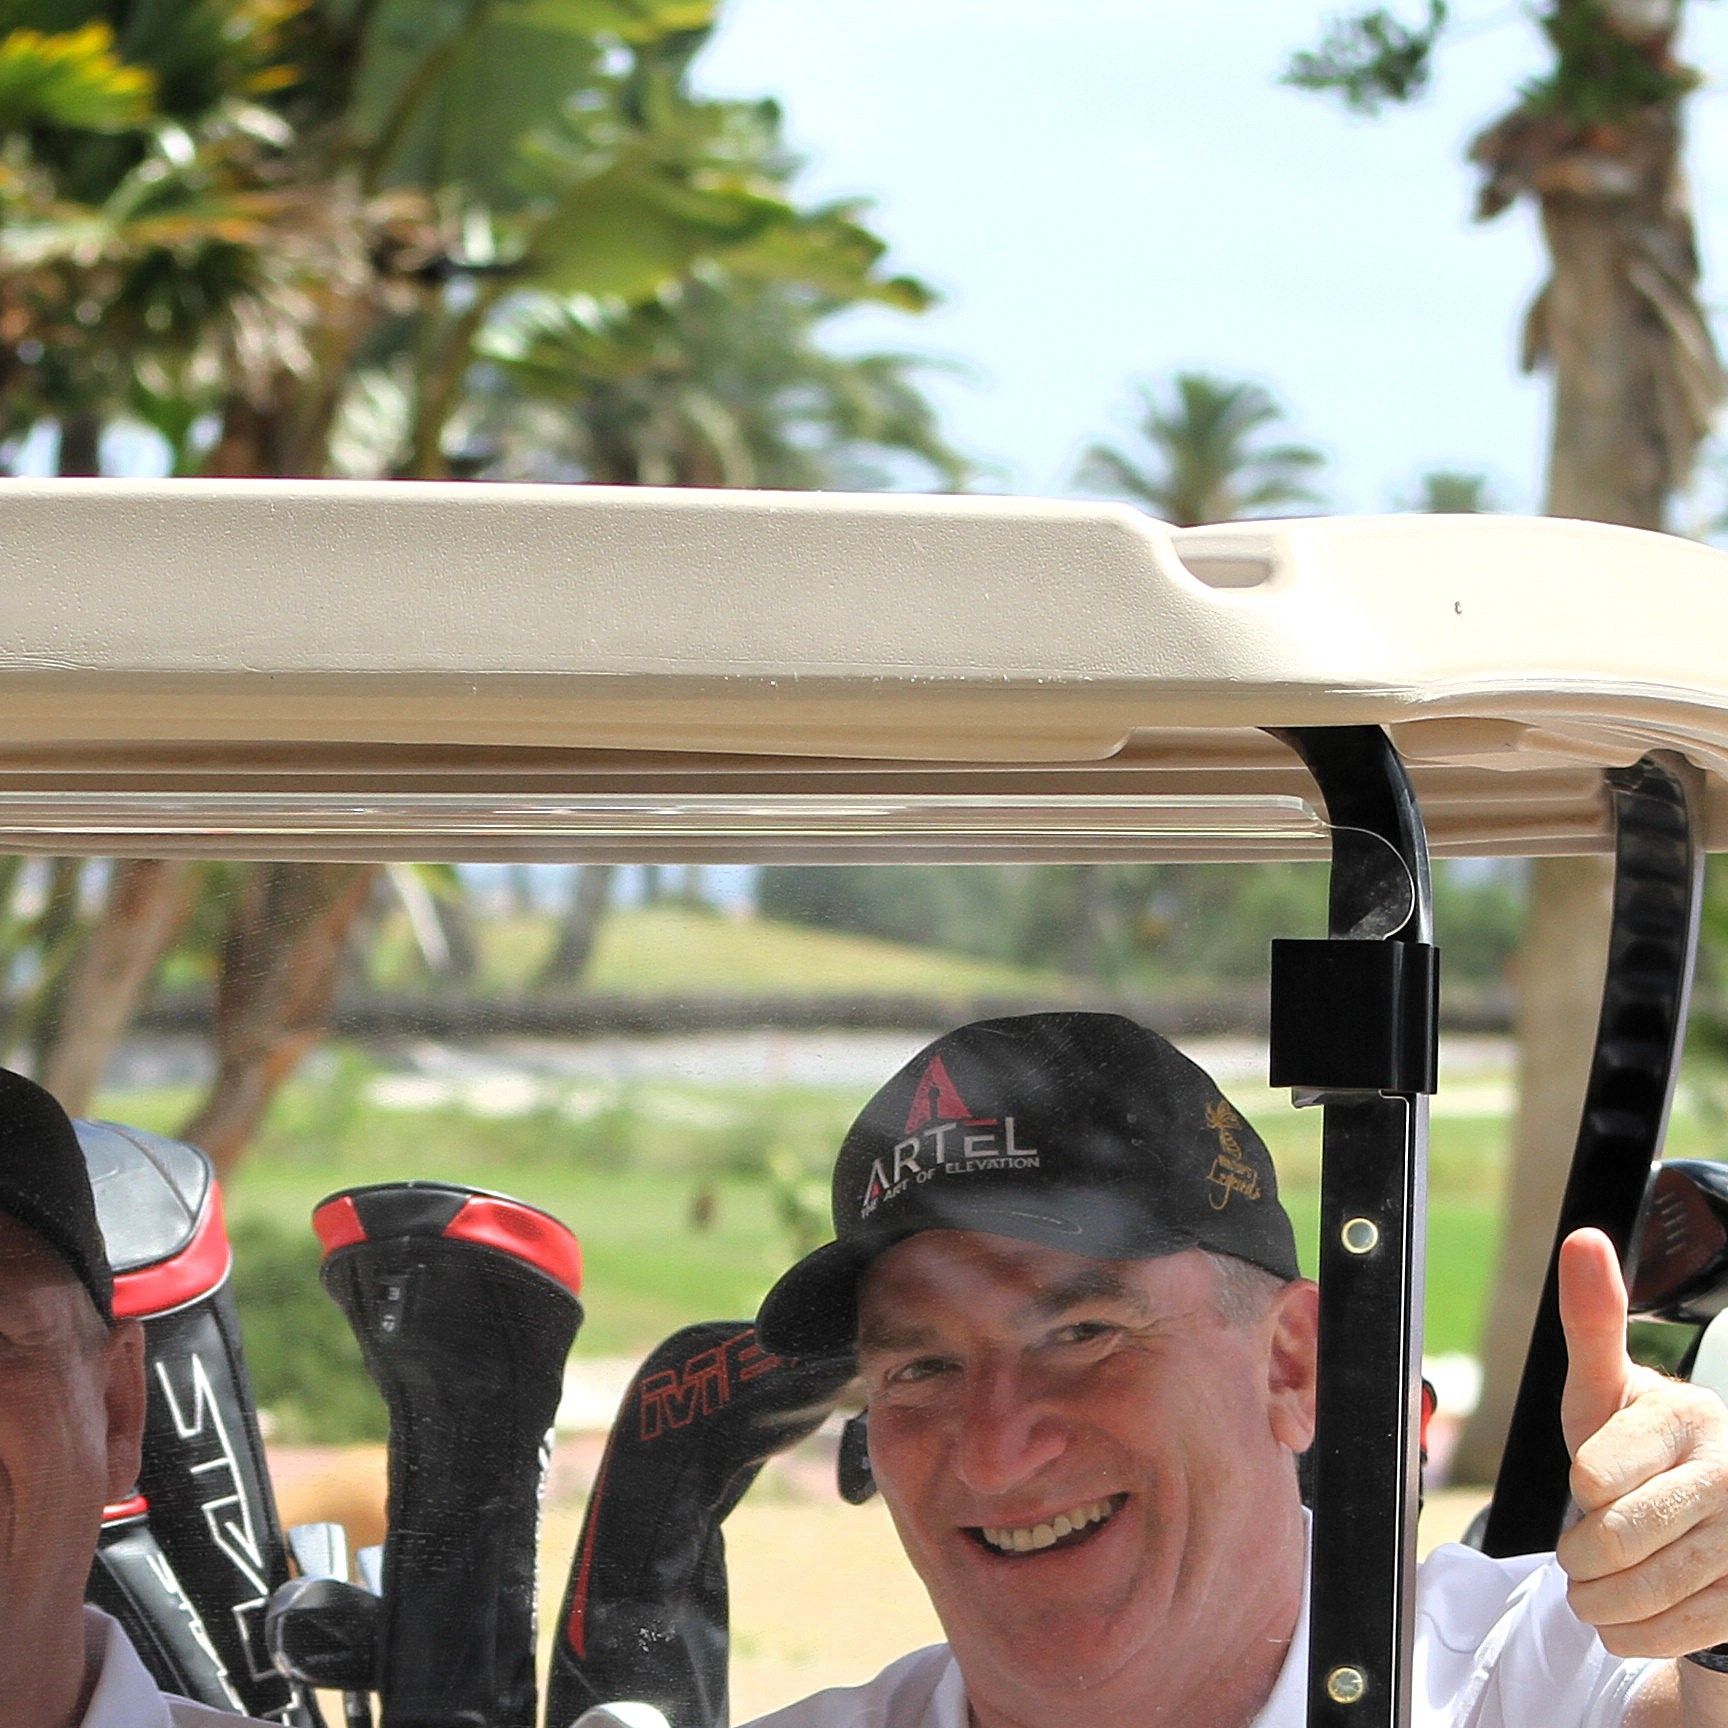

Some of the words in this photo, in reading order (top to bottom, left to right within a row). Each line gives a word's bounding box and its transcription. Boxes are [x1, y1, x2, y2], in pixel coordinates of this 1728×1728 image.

[863, 1116, 1038, 1208] ARTEL
[883, 1178, 910, 1203] ART
[916, 1168, 937, 1185] OF
[945, 1156, 1040, 1175] ELEVATION
